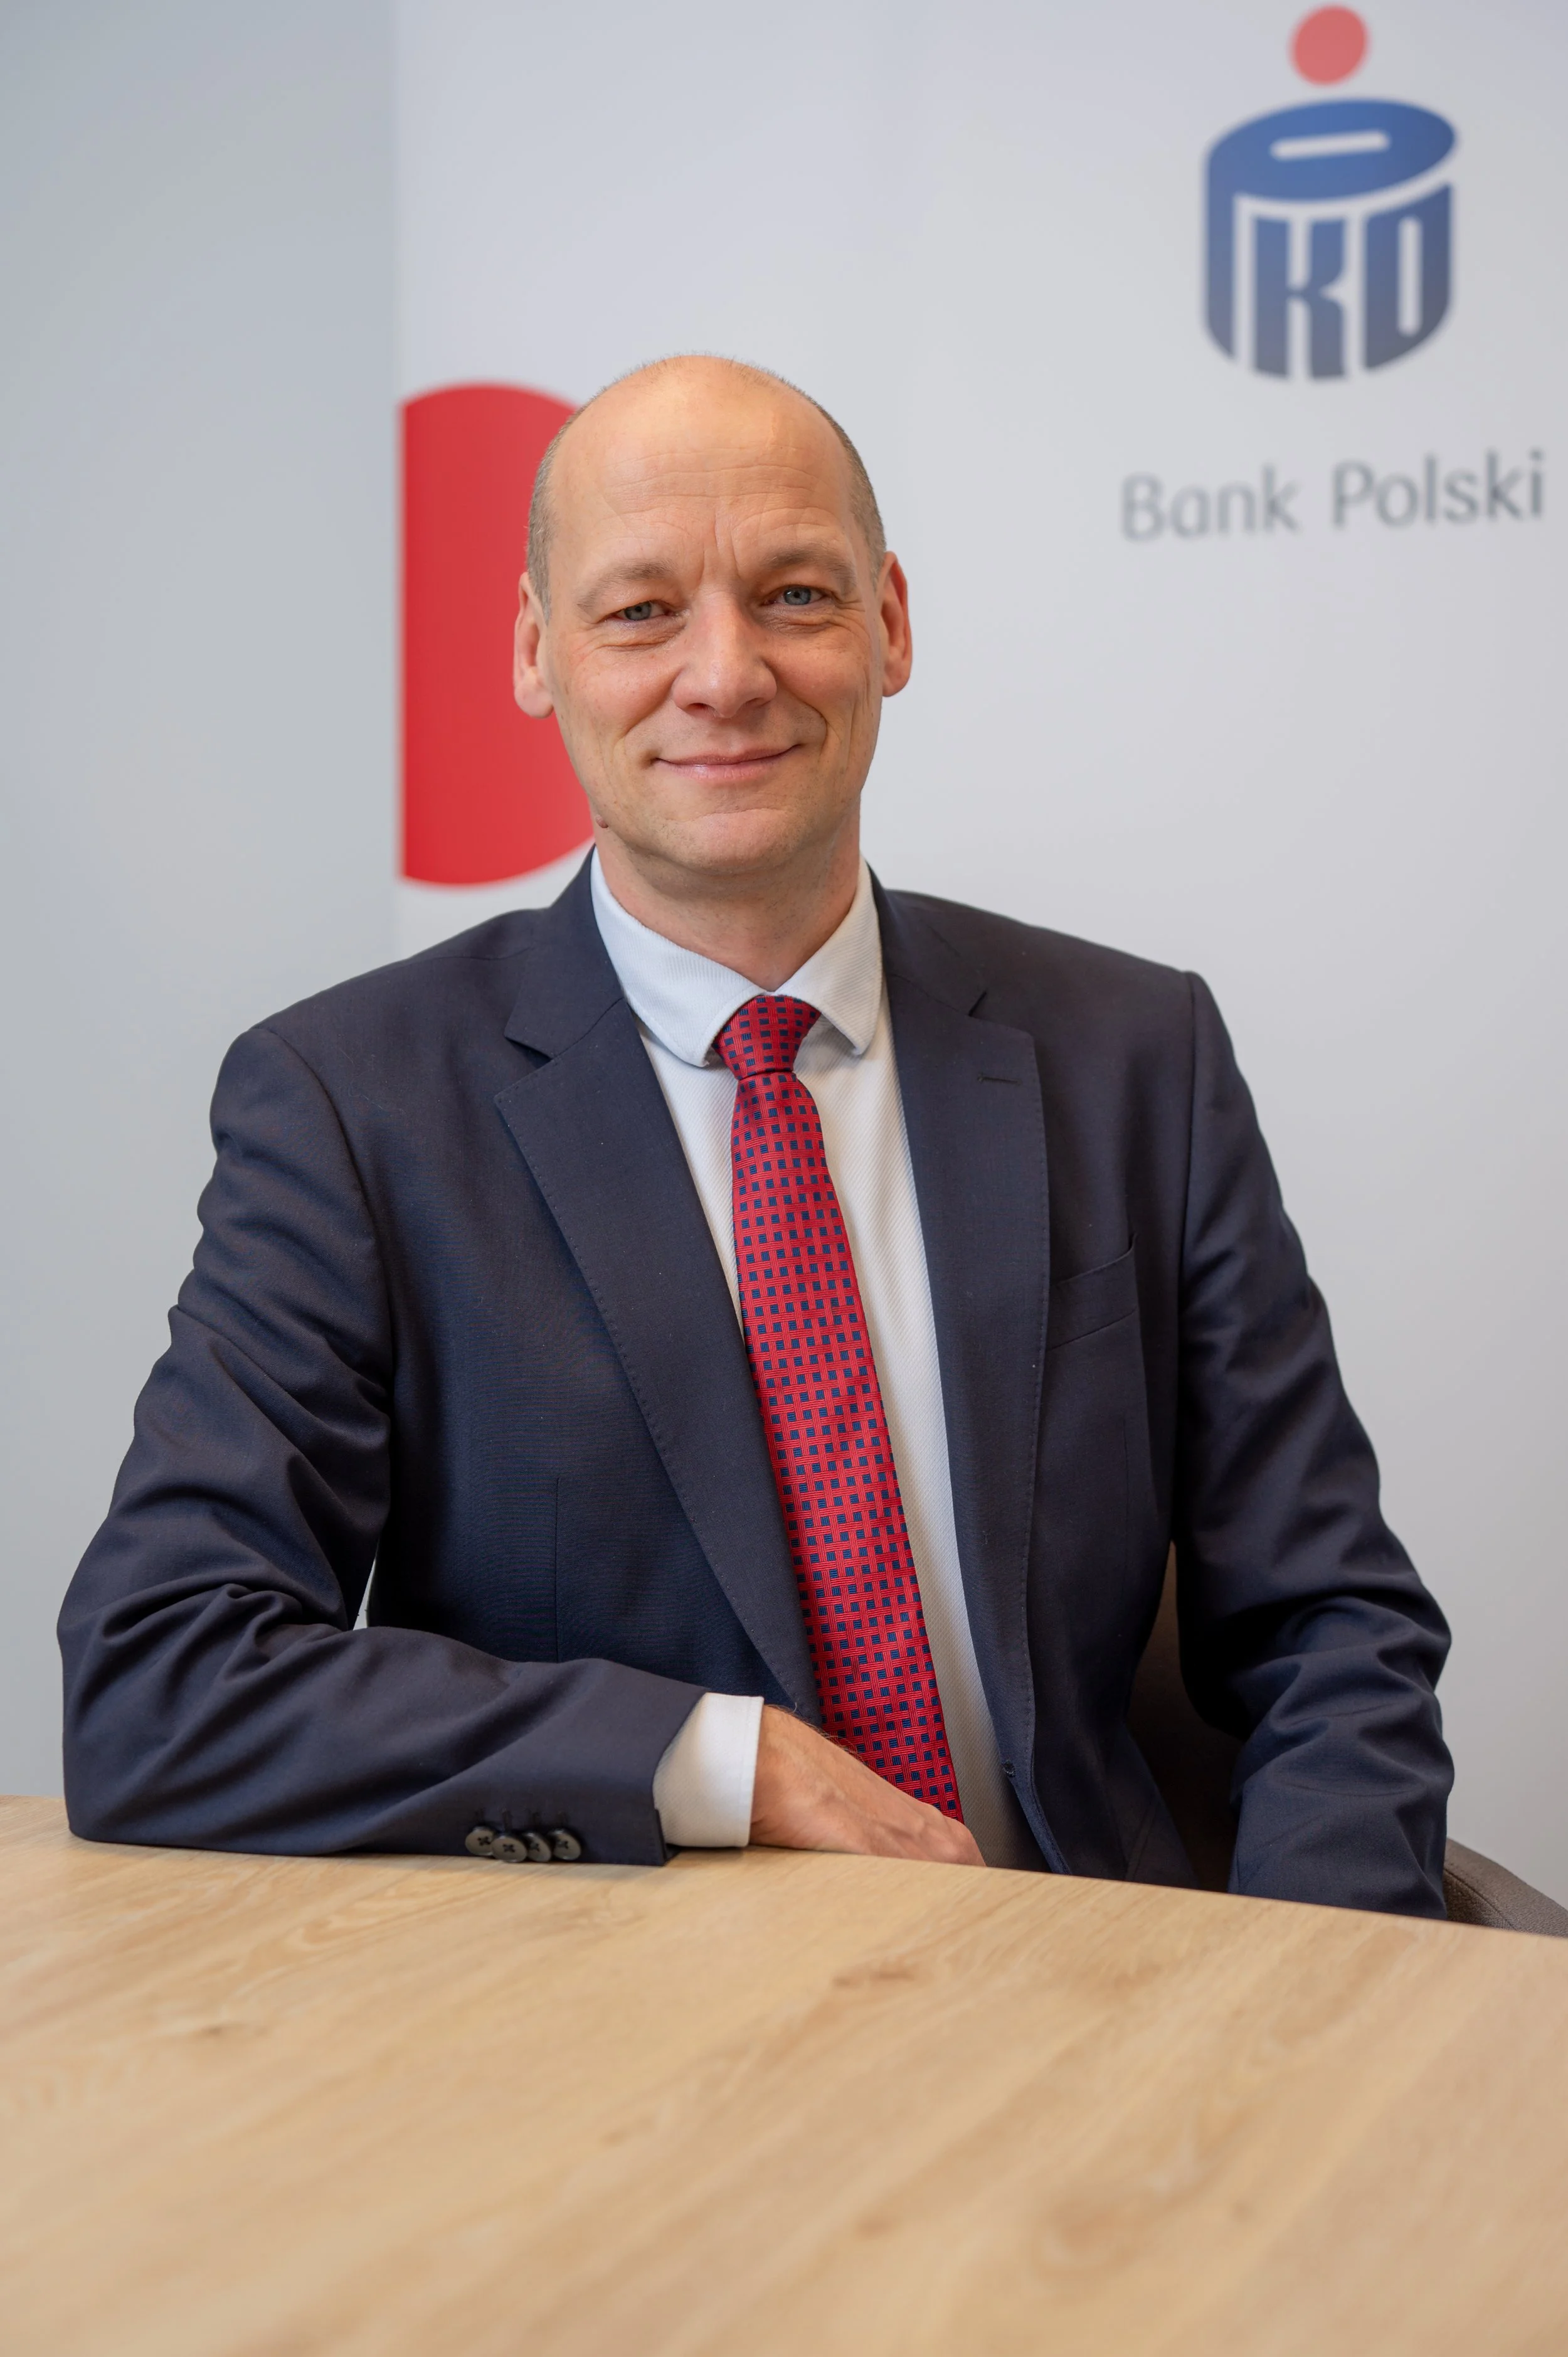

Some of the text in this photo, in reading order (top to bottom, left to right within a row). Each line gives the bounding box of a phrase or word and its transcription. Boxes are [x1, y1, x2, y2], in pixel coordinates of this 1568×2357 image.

[1204, 98, 1457, 380] PKO
[1122, 449, 1544, 540] Bank Polski
